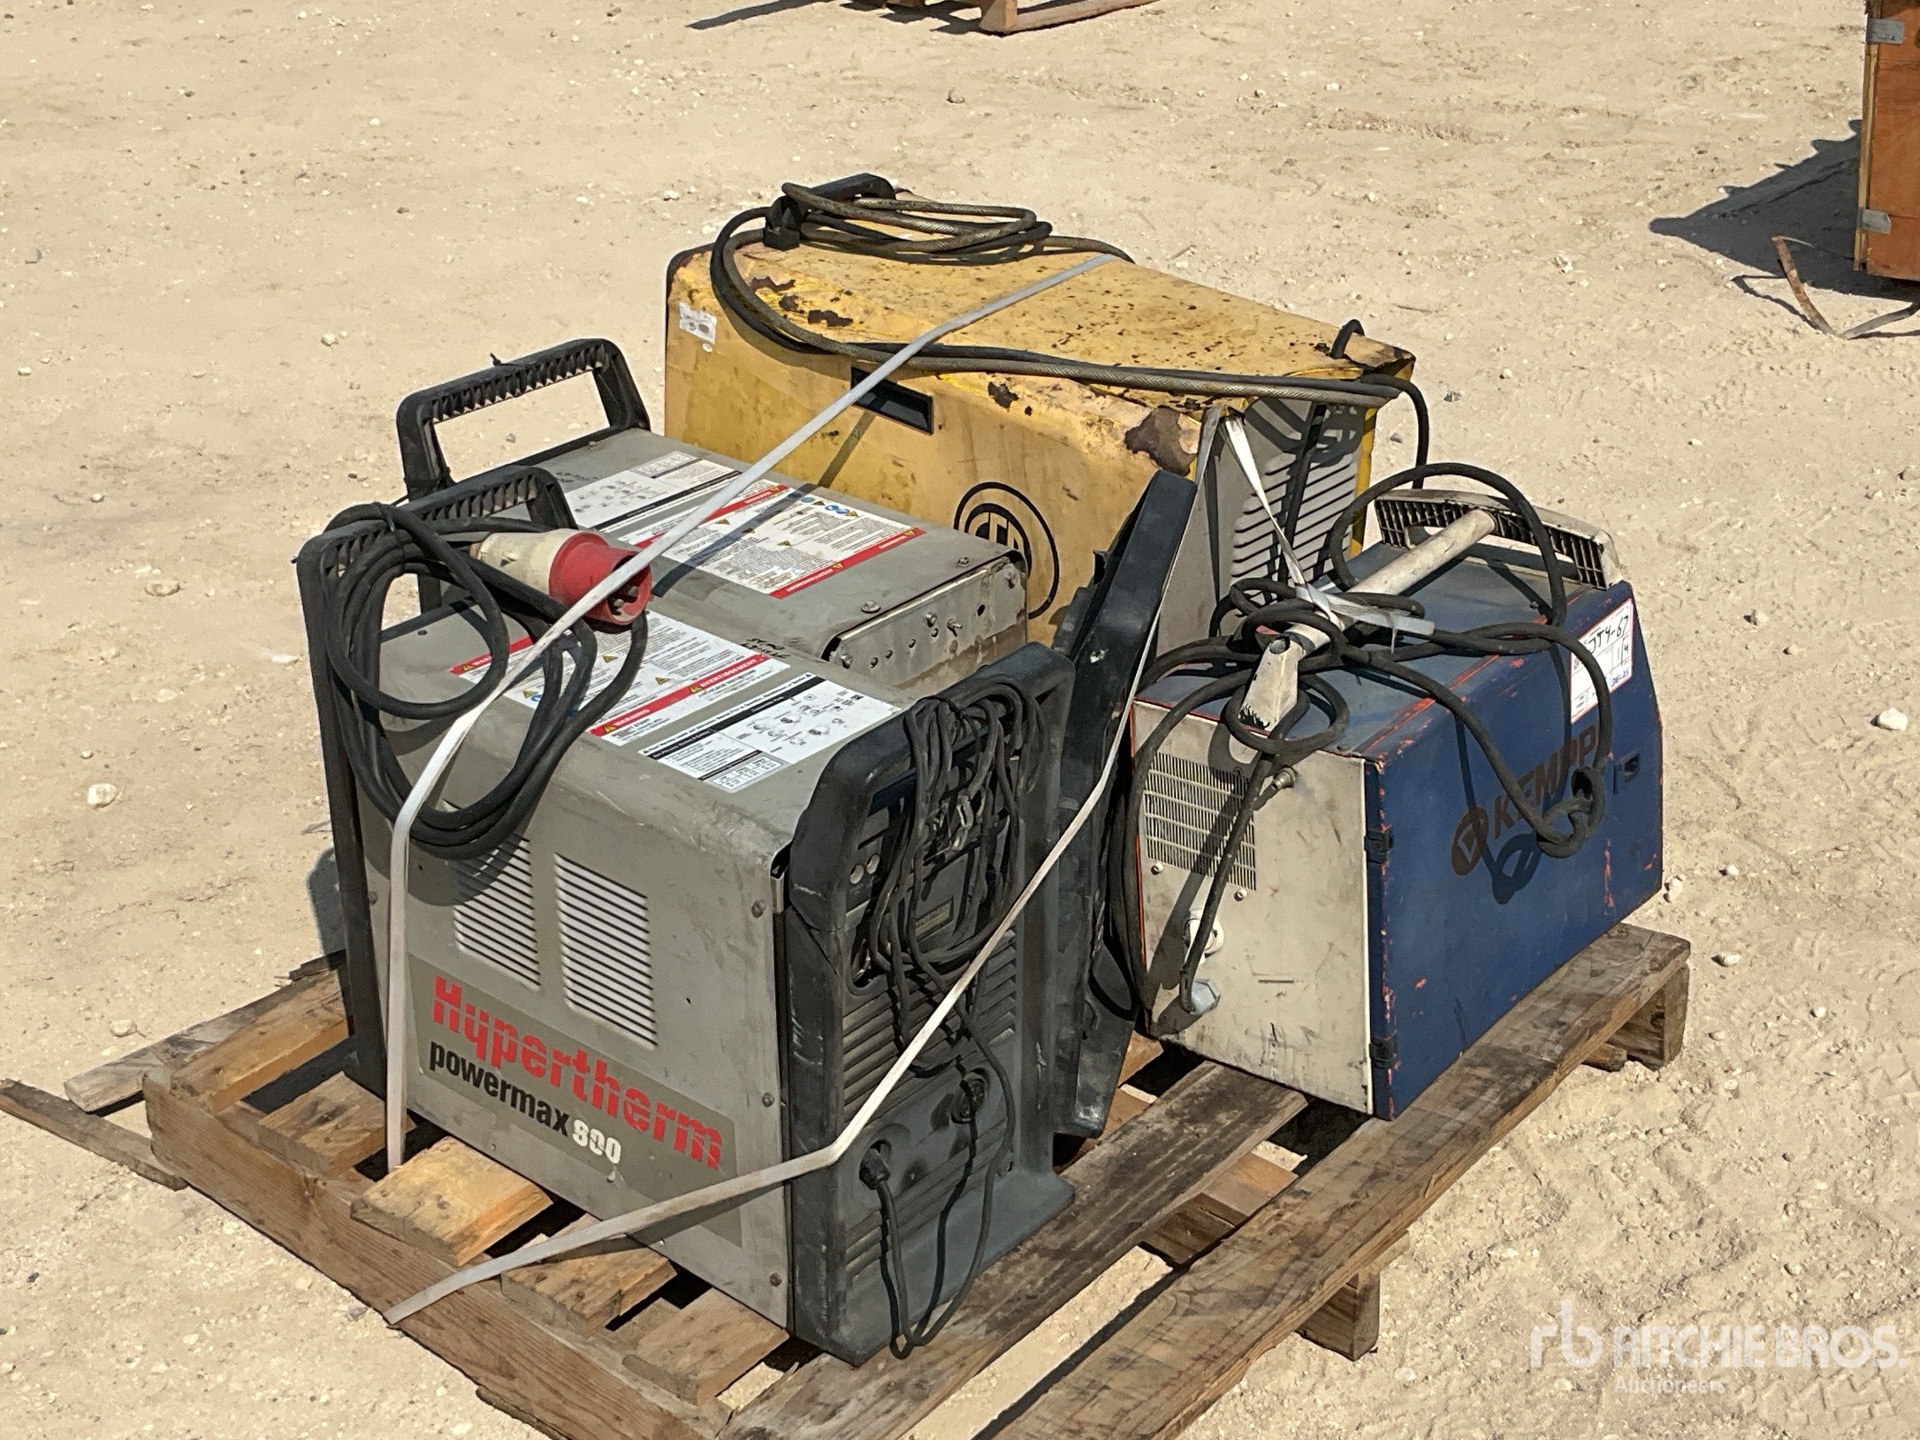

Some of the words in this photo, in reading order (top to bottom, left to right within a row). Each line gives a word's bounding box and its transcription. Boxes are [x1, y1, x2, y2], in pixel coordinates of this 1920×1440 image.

[429, 1041, 570, 1137] powermax
[572, 1118, 622, 1165] 800
[432, 975, 723, 1170] Hypertherm
